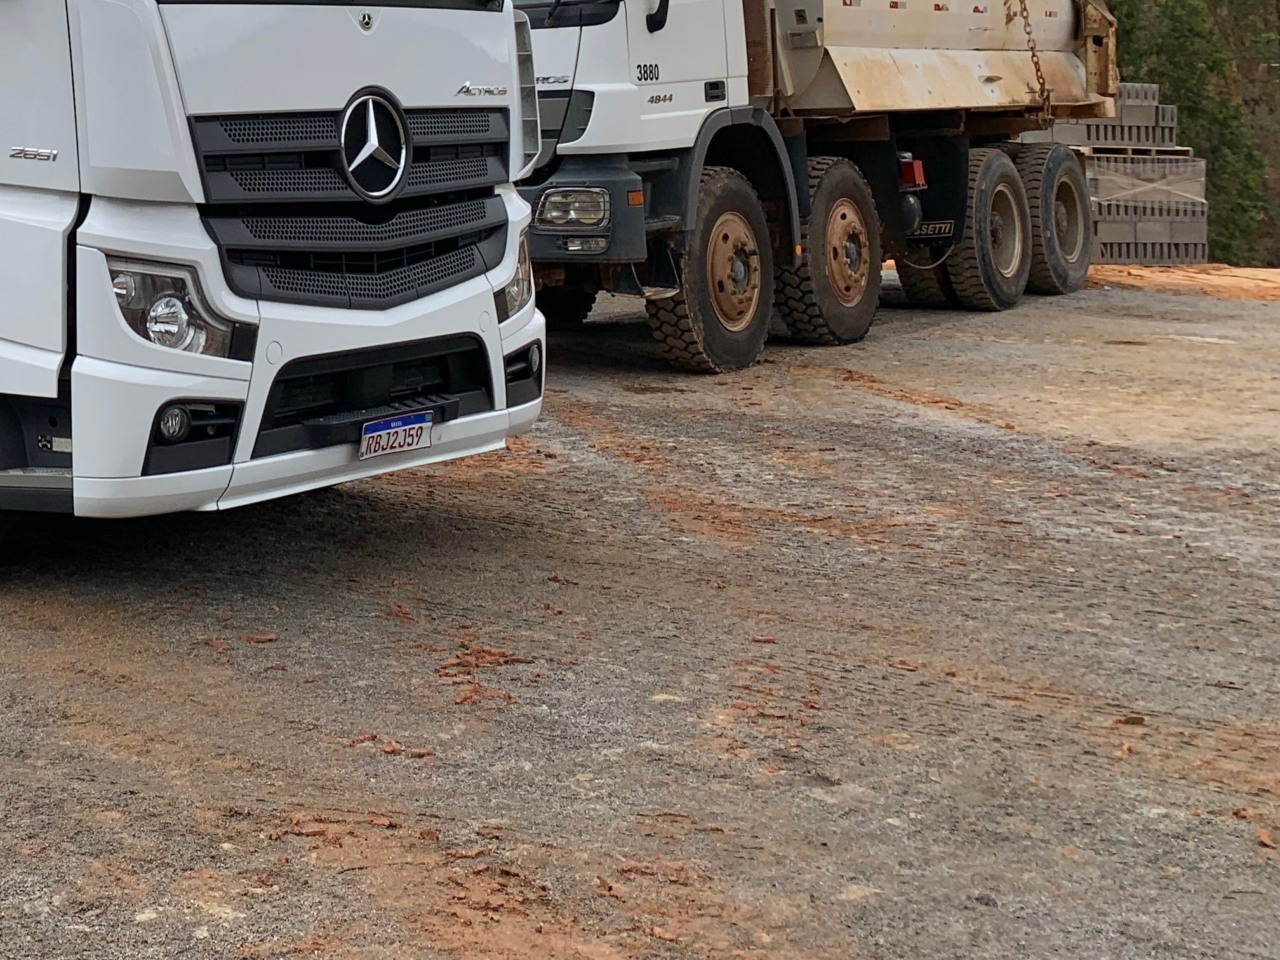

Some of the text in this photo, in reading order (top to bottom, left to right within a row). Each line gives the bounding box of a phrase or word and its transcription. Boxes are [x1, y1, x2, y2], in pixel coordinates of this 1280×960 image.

[535, 75, 570, 85] ROS
[636, 63, 660, 82] 3880
[647, 93, 673, 105] 4844
[9, 146, 58, 162] 2651
[365, 425, 424, 456] RBJ2J59
